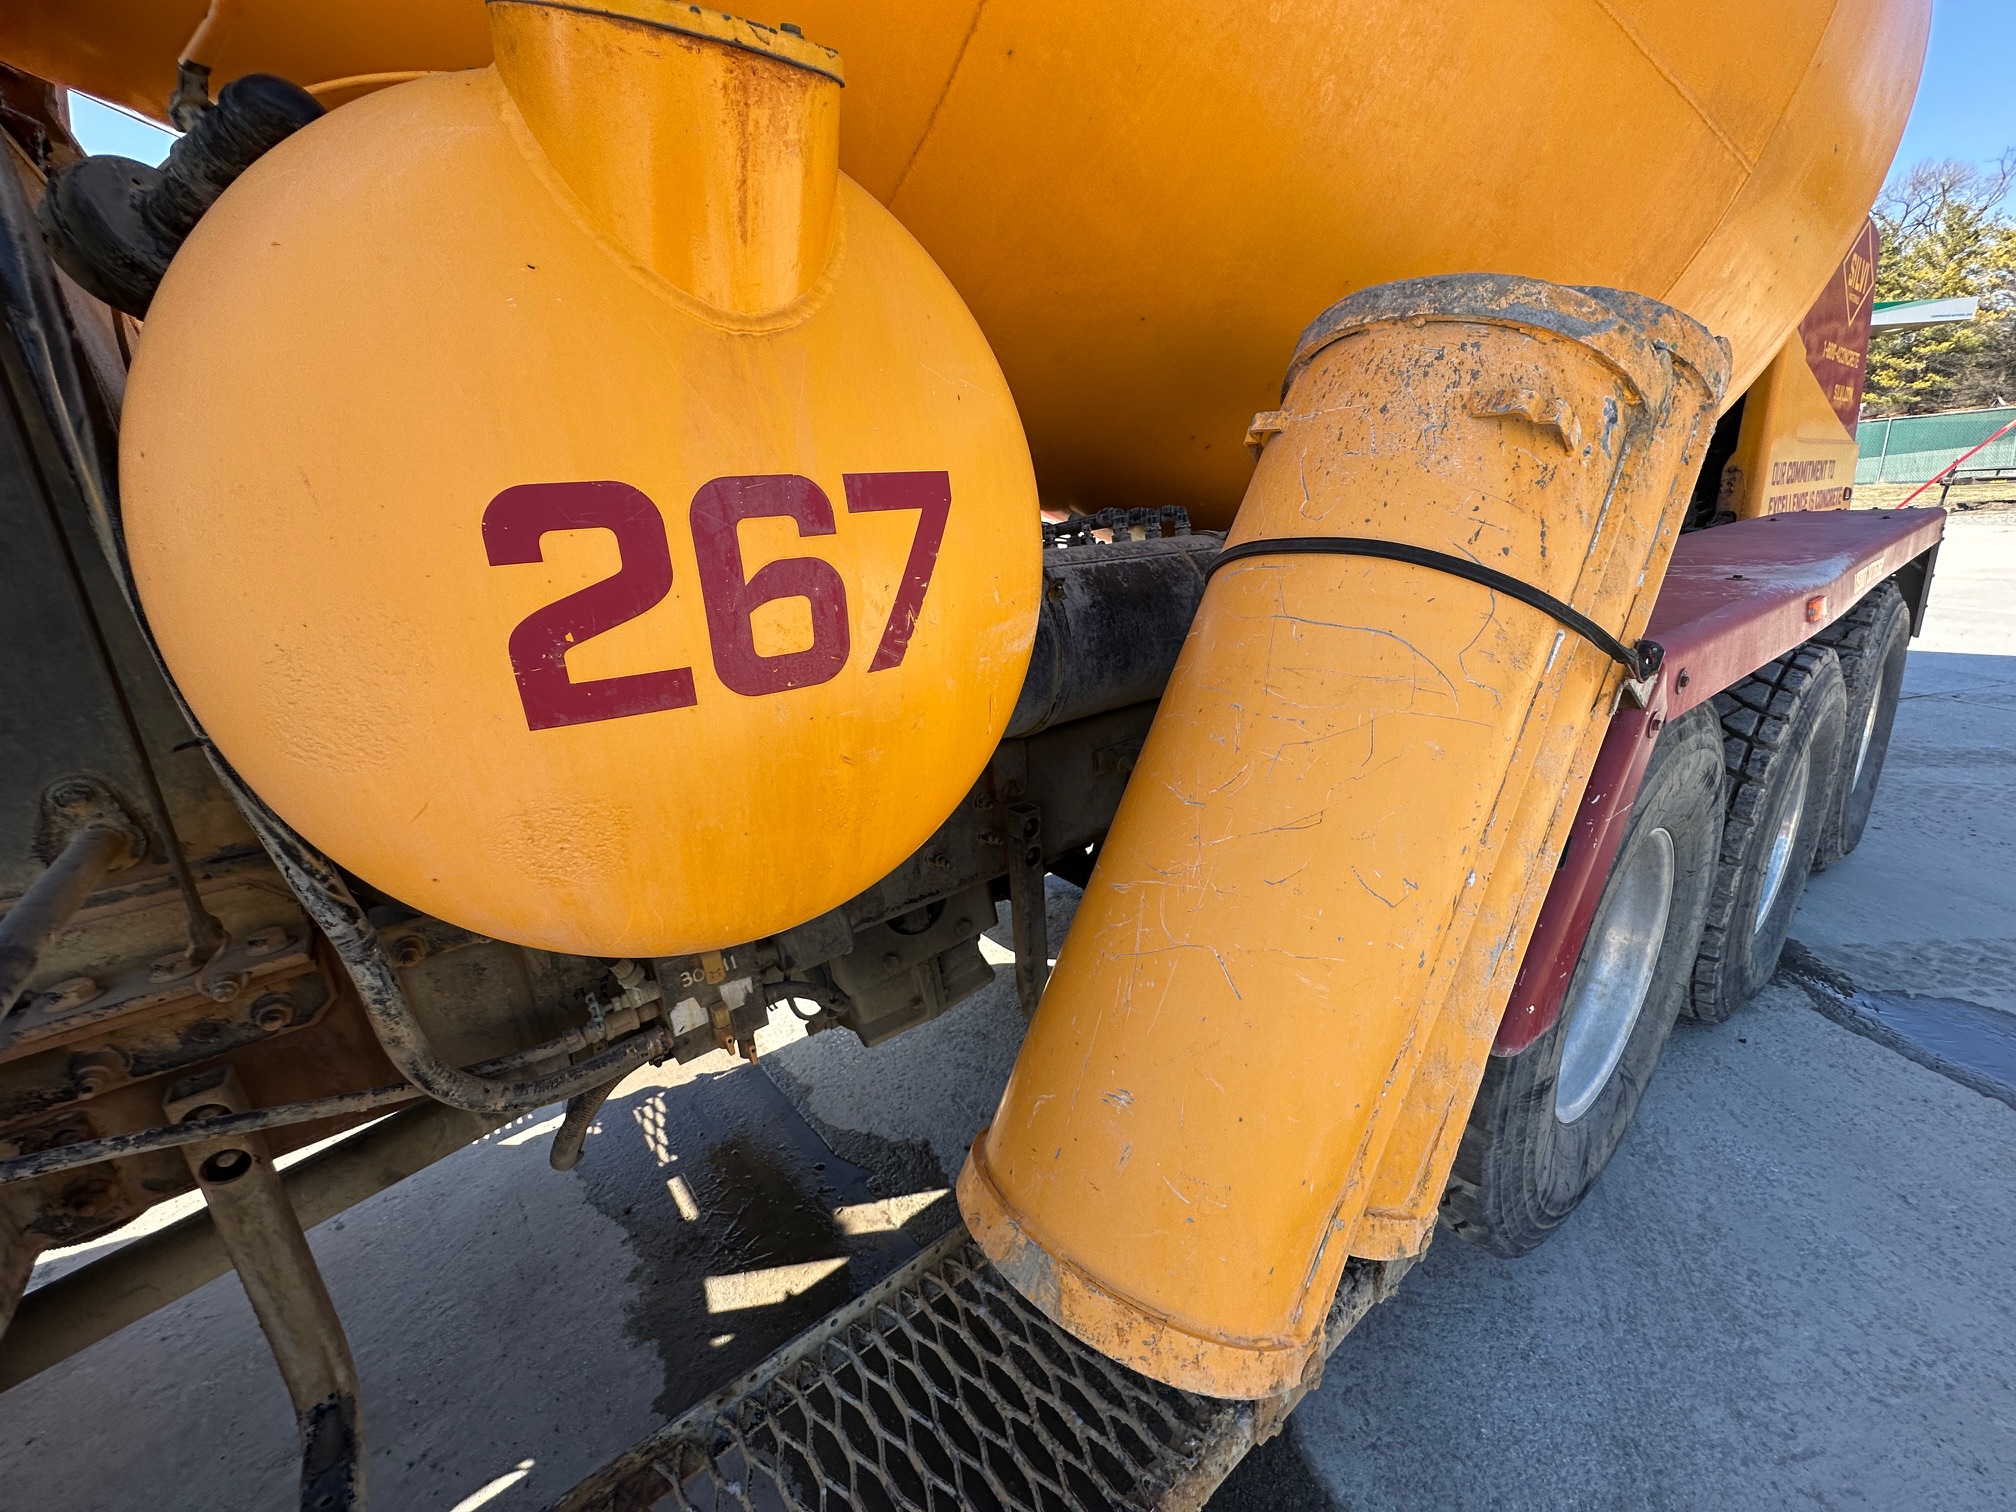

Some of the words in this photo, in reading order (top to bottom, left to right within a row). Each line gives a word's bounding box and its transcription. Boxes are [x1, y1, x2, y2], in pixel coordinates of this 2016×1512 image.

[1848, 252, 1871, 294] SILVI
[1771, 461, 1787, 486] OUR
[1786, 460, 1828, 484] COMMITMENT
[1827, 460, 1836, 479] TO
[1808, 490, 1815, 510] IS
[1814, 486, 1843, 511] CONCRETE
[481, 470, 952, 731] 267
